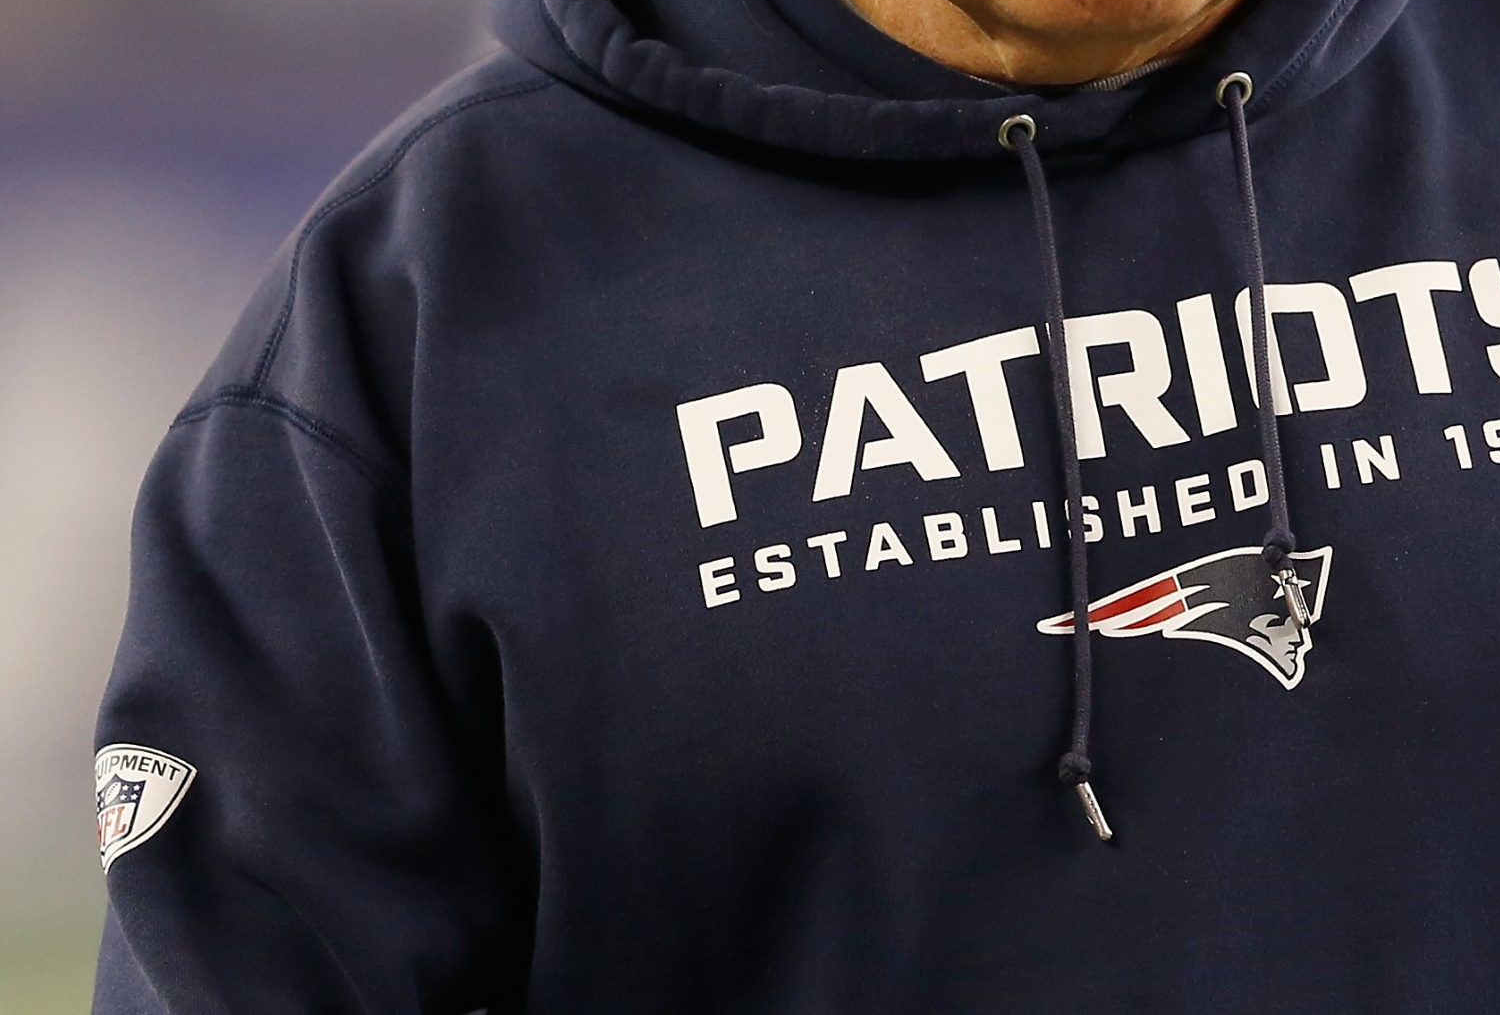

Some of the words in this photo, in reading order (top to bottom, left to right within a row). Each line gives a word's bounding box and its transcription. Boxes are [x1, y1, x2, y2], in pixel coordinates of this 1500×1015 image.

[699, 459, 1270, 610] ESTABLISHED
[1319, 435, 1402, 490] IN
[97, 754, 181, 782] UIPMENT
